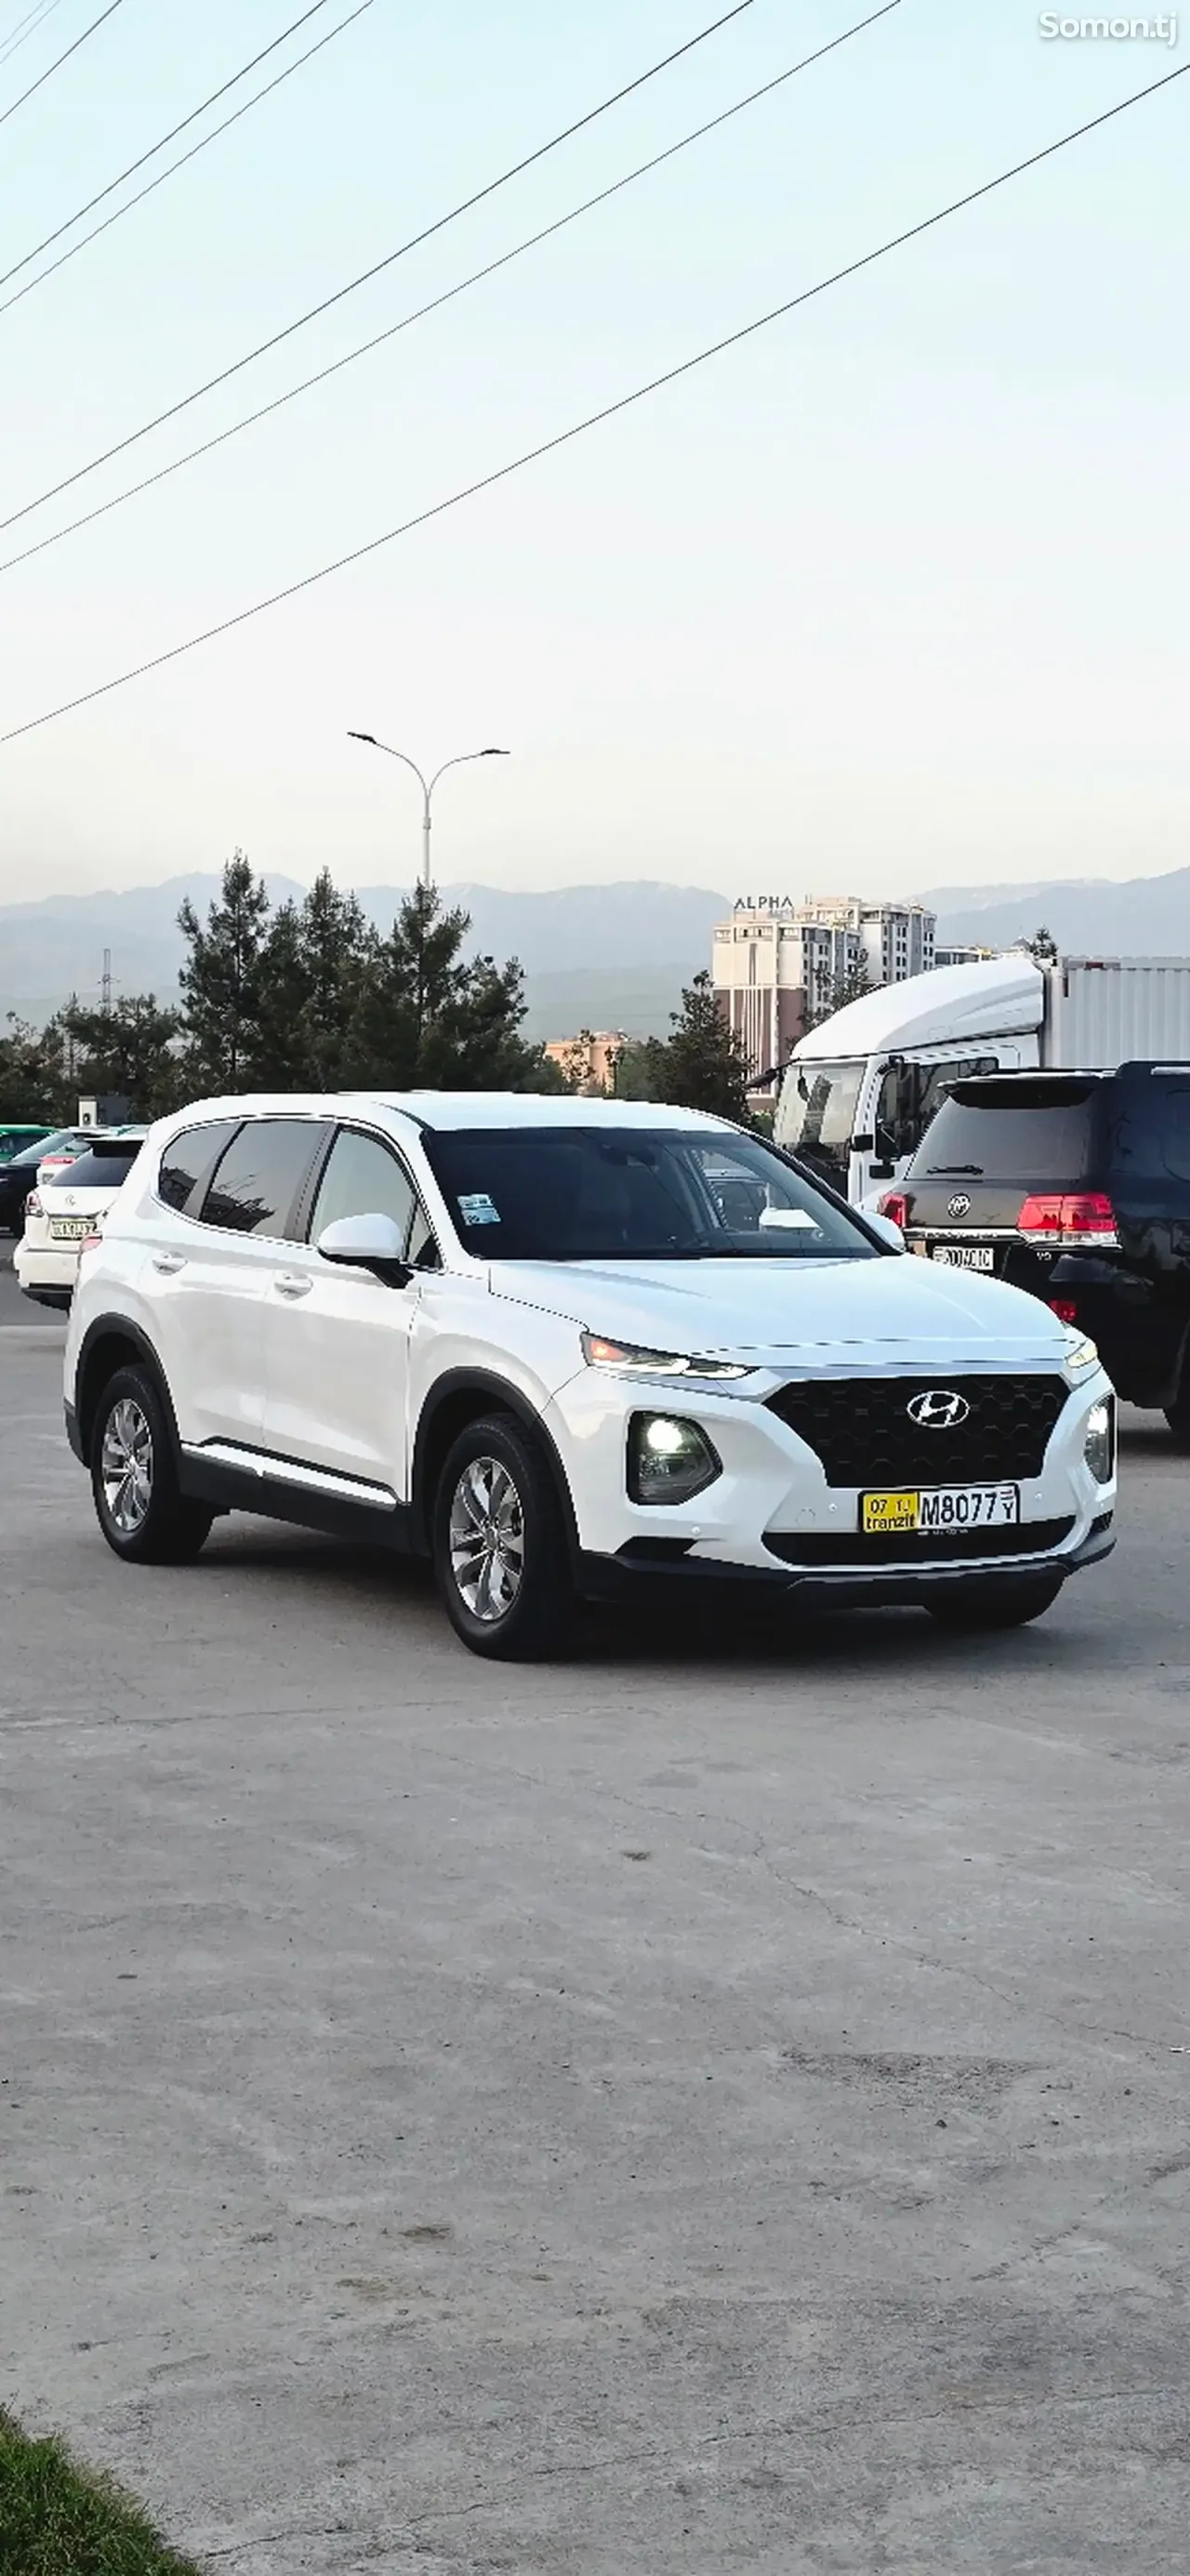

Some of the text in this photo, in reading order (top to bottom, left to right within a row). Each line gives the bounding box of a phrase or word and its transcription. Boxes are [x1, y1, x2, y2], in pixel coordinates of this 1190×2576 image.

[734, 896, 793, 910] ALPHA
[870, 1498, 888, 1514] 07
[921, 1493, 998, 1526] M8077
[866, 1513, 916, 1530] tranzit
